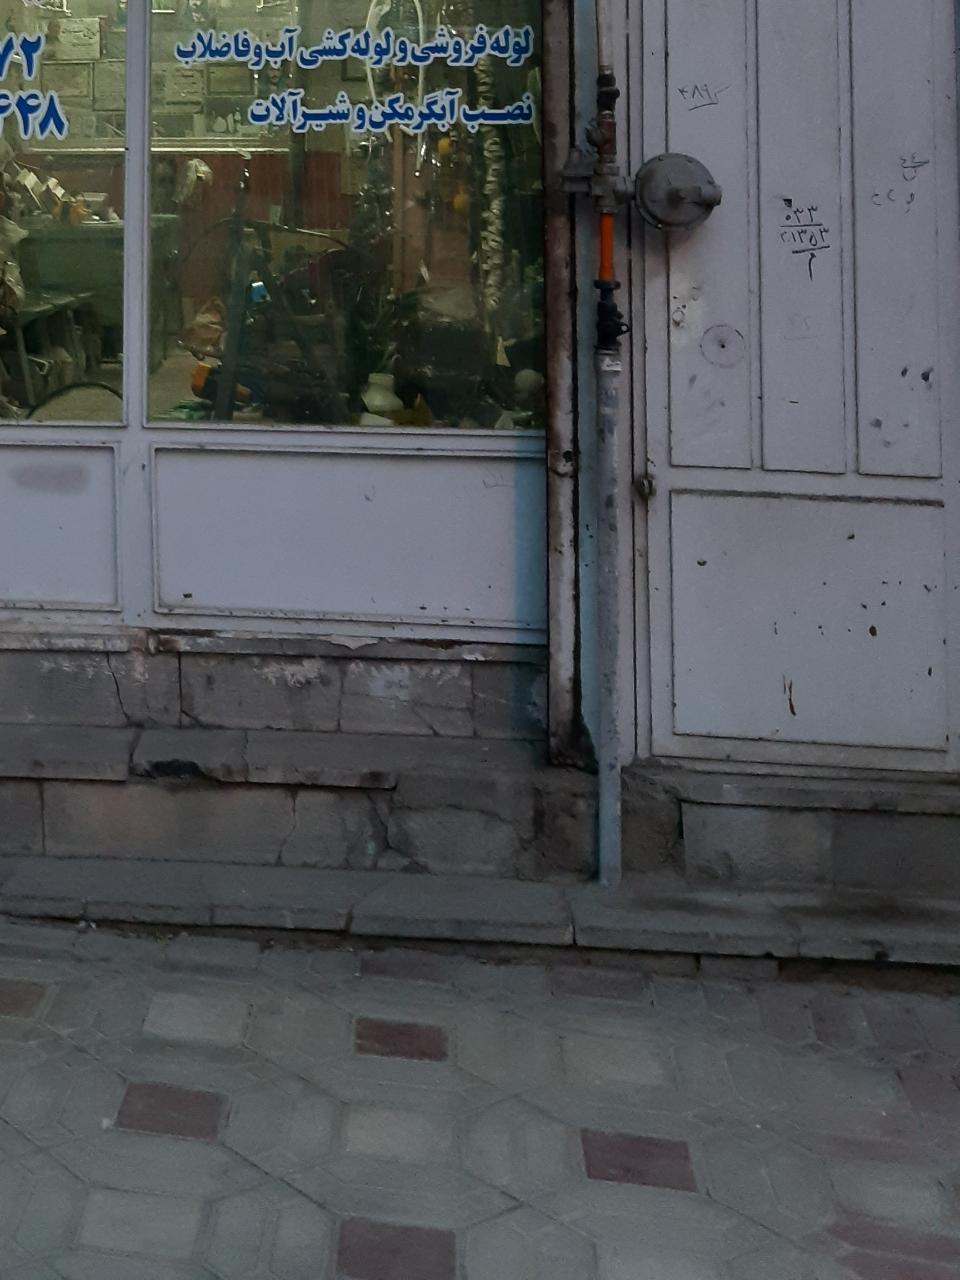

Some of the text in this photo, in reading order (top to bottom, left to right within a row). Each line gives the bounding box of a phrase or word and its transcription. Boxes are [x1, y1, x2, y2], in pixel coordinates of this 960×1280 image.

[174, 28, 254, 66] فاضلاب
[264, 25, 301, 68] آب
[297, 29, 353, 69] کشی
[350, 26, 394, 68] لوله
[410, 24, 490, 66] فروشی
[490, 25, 534, 67] لوله
[460, 92, 536, 133] نصب
